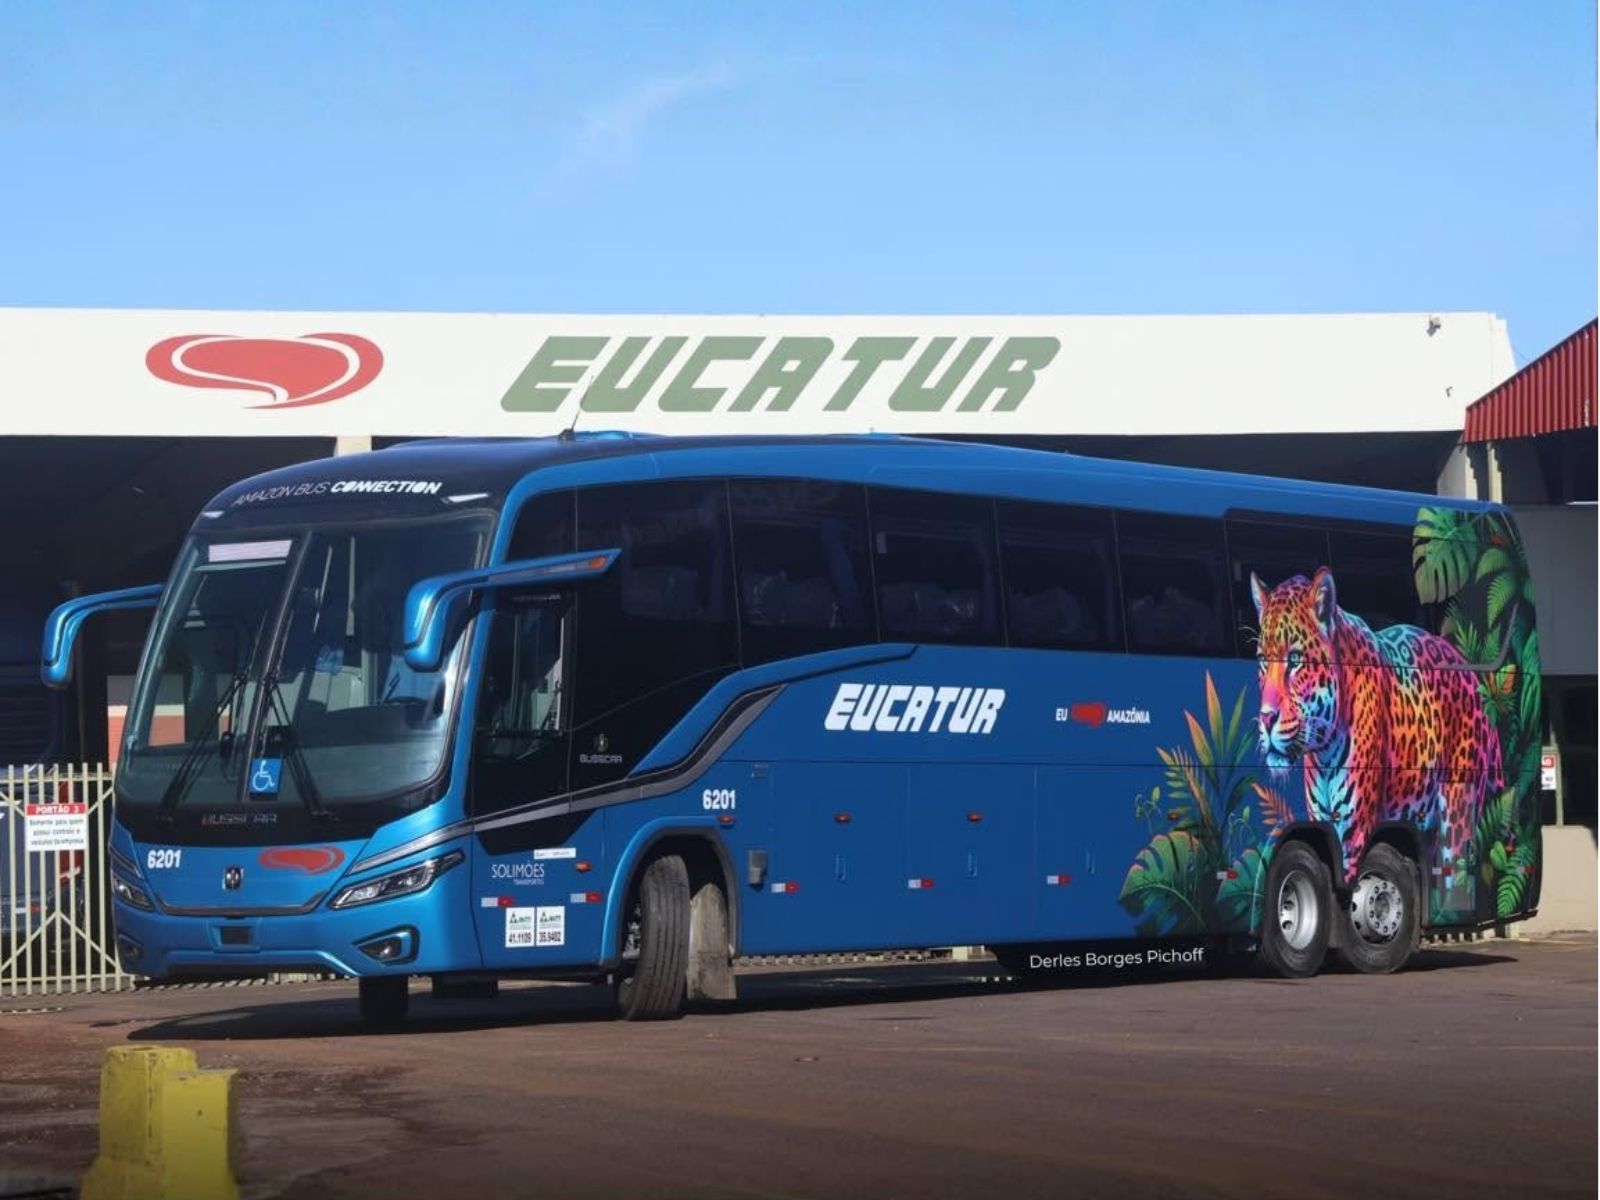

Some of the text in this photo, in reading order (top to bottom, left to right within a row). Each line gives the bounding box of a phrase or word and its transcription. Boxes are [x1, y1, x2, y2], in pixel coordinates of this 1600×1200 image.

[500, 336, 1061, 413] EUCATUR
[232, 480, 442, 506] AMAZON BUS CONNECTION
[824, 682, 1006, 734] EUCATUR
[1055, 706, 1150, 724] EU AMAZÔNIA
[579, 754, 622, 764] BUSSCAR
[702, 788, 736, 810] 6201
[35, 805, 70, 814] PORTÃO
[147, 849, 182, 869] 6201
[491, 860, 545, 878] SOLIMÕES
